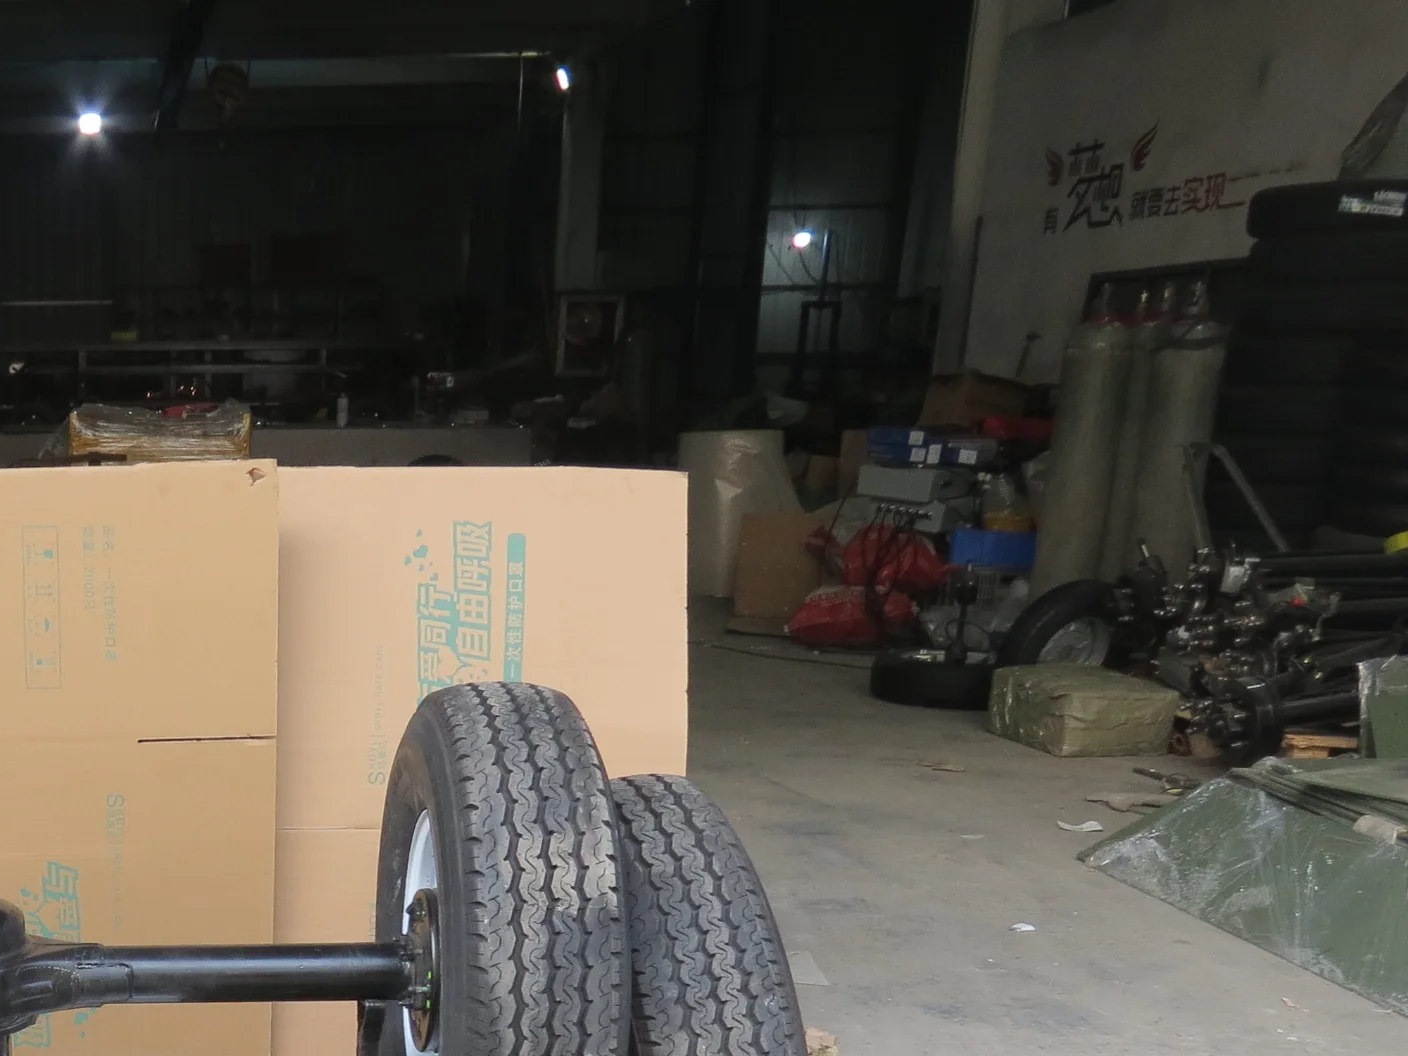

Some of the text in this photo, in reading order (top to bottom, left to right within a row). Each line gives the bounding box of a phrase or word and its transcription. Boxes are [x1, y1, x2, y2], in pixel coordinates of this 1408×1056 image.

[454, 521, 491, 660] 自由呼吸
[506, 560, 524, 680] 一次性防护口罩
